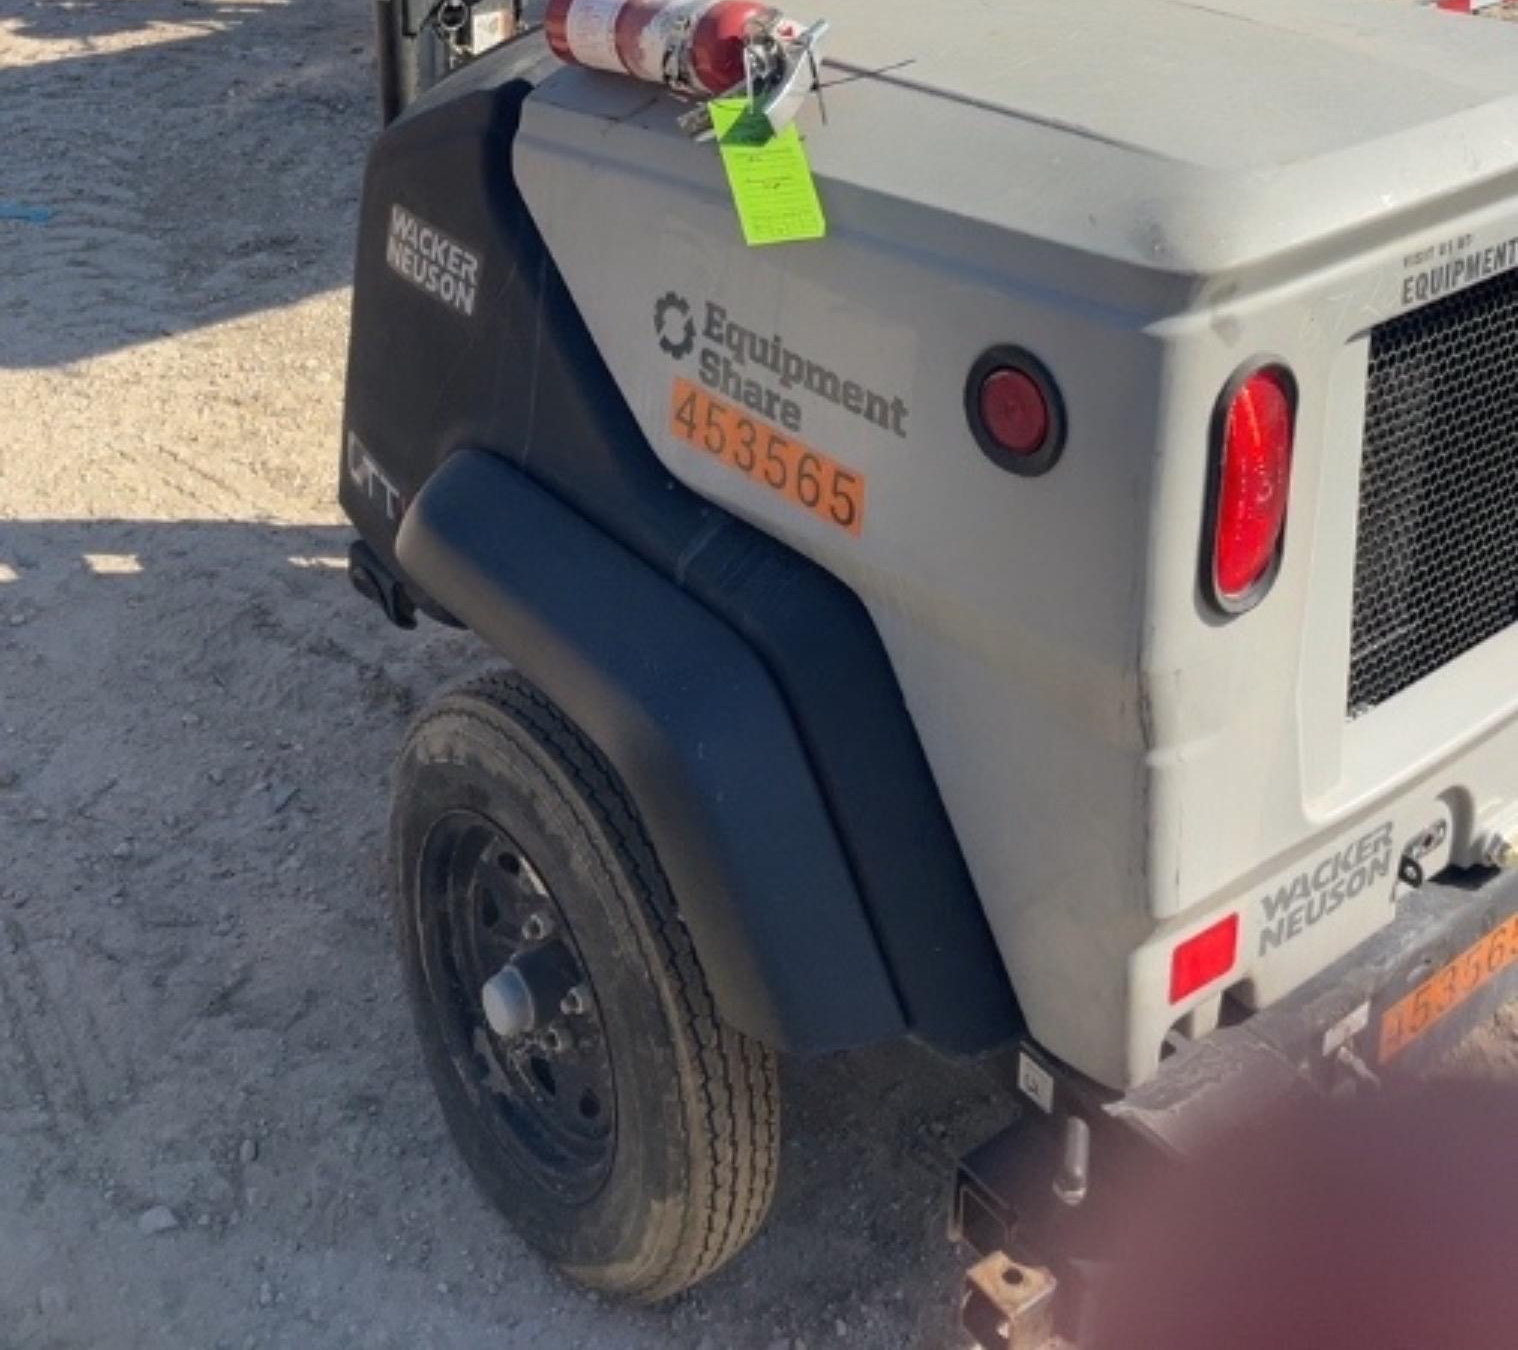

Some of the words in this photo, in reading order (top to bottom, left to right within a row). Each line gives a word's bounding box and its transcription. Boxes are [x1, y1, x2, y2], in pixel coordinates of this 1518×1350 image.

[386, 236, 474, 316] NEUSON
[392, 202, 479, 286] WACKER
[1401, 237, 1518, 305] EQUIPMENT
[698, 347, 801, 432] Share
[701, 300, 909, 438] Equipment
[675, 389, 857, 527] 453565
[1259, 849, 1391, 956] NEUSON
[1261, 821, 1393, 921] WACKER
